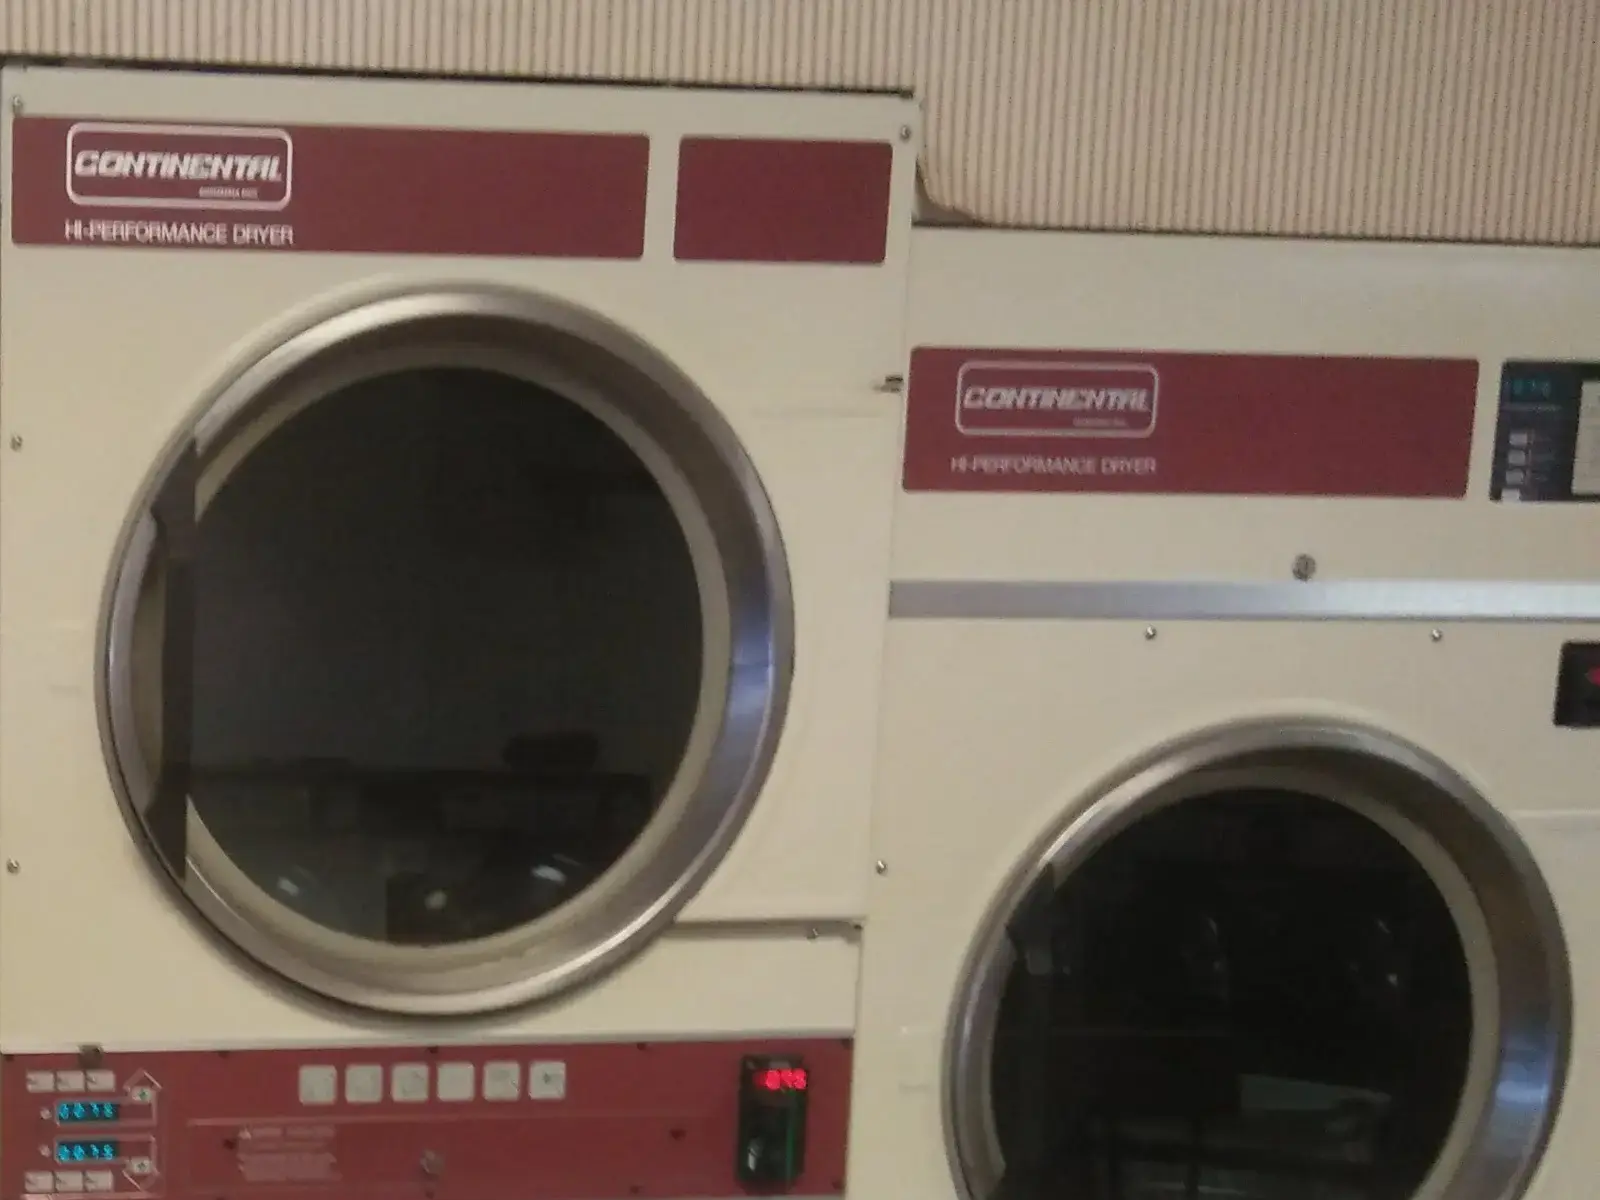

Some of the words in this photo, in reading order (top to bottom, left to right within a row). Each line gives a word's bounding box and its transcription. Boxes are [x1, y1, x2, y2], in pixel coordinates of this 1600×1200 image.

[75, 150, 282, 182] CONTINENTAL
[65, 219, 228, 245] HI-PERFORMANCE
[233, 223, 294, 246] DRYER
[963, 387, 1151, 412] CONTINENTAL
[950, 456, 1096, 475] HI-PERFORMANCE
[1101, 456, 1157, 476] DRYER
